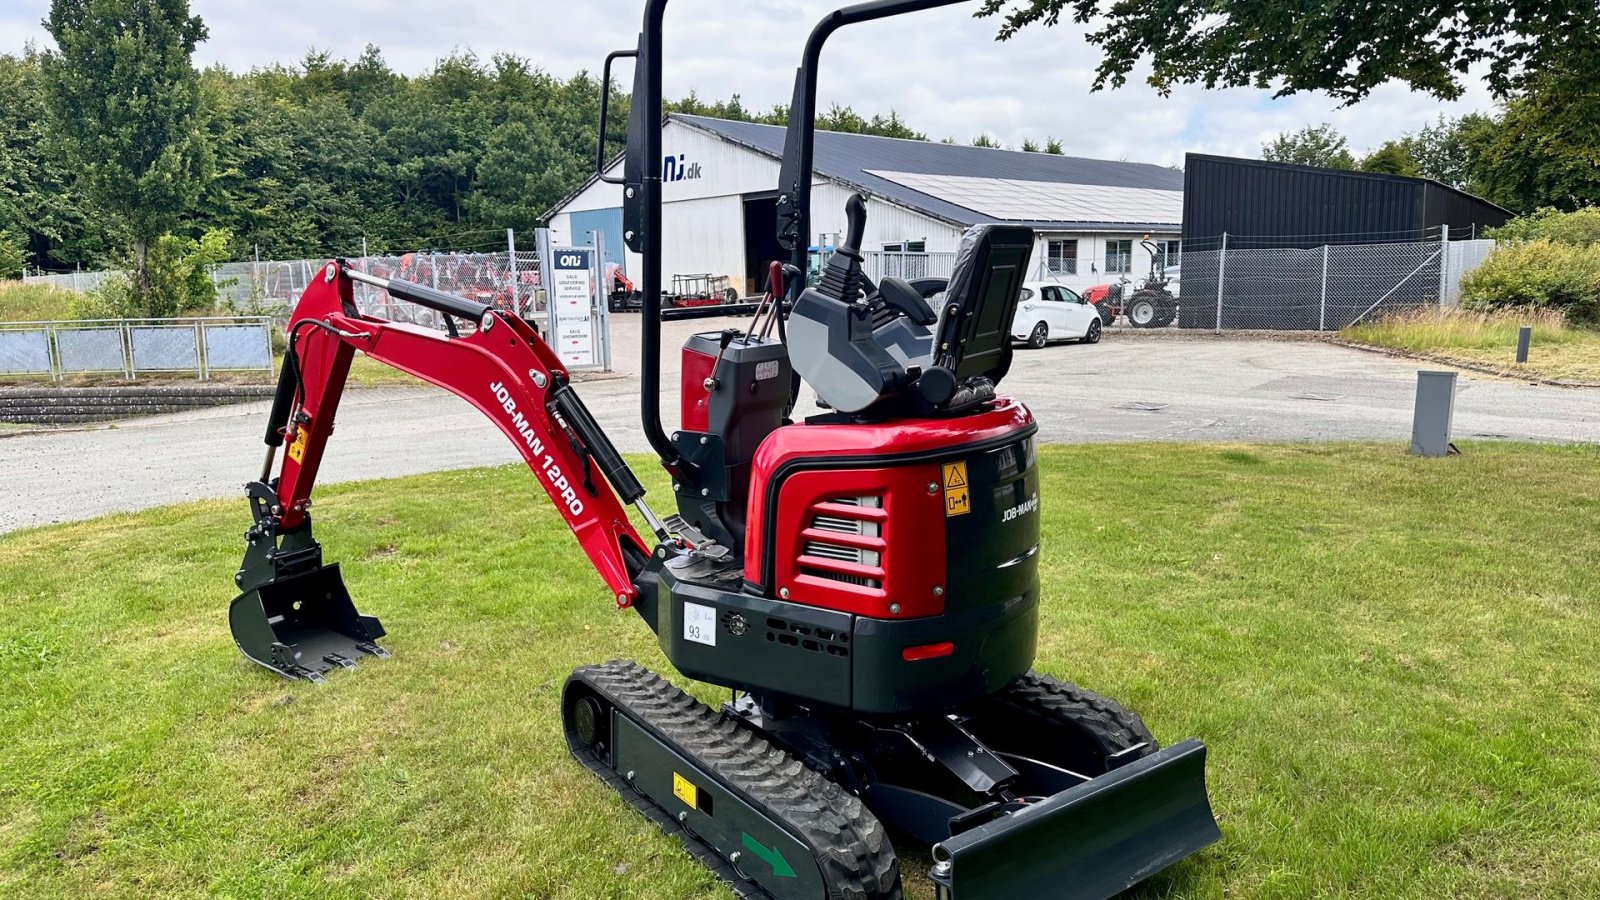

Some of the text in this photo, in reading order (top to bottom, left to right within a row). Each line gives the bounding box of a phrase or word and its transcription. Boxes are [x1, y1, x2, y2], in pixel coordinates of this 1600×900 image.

[490, 381, 584, 516] JOB-MAN 12PRO
[1001, 499, 1032, 523] JOB-MAN
[688, 625, 700, 639] 93
